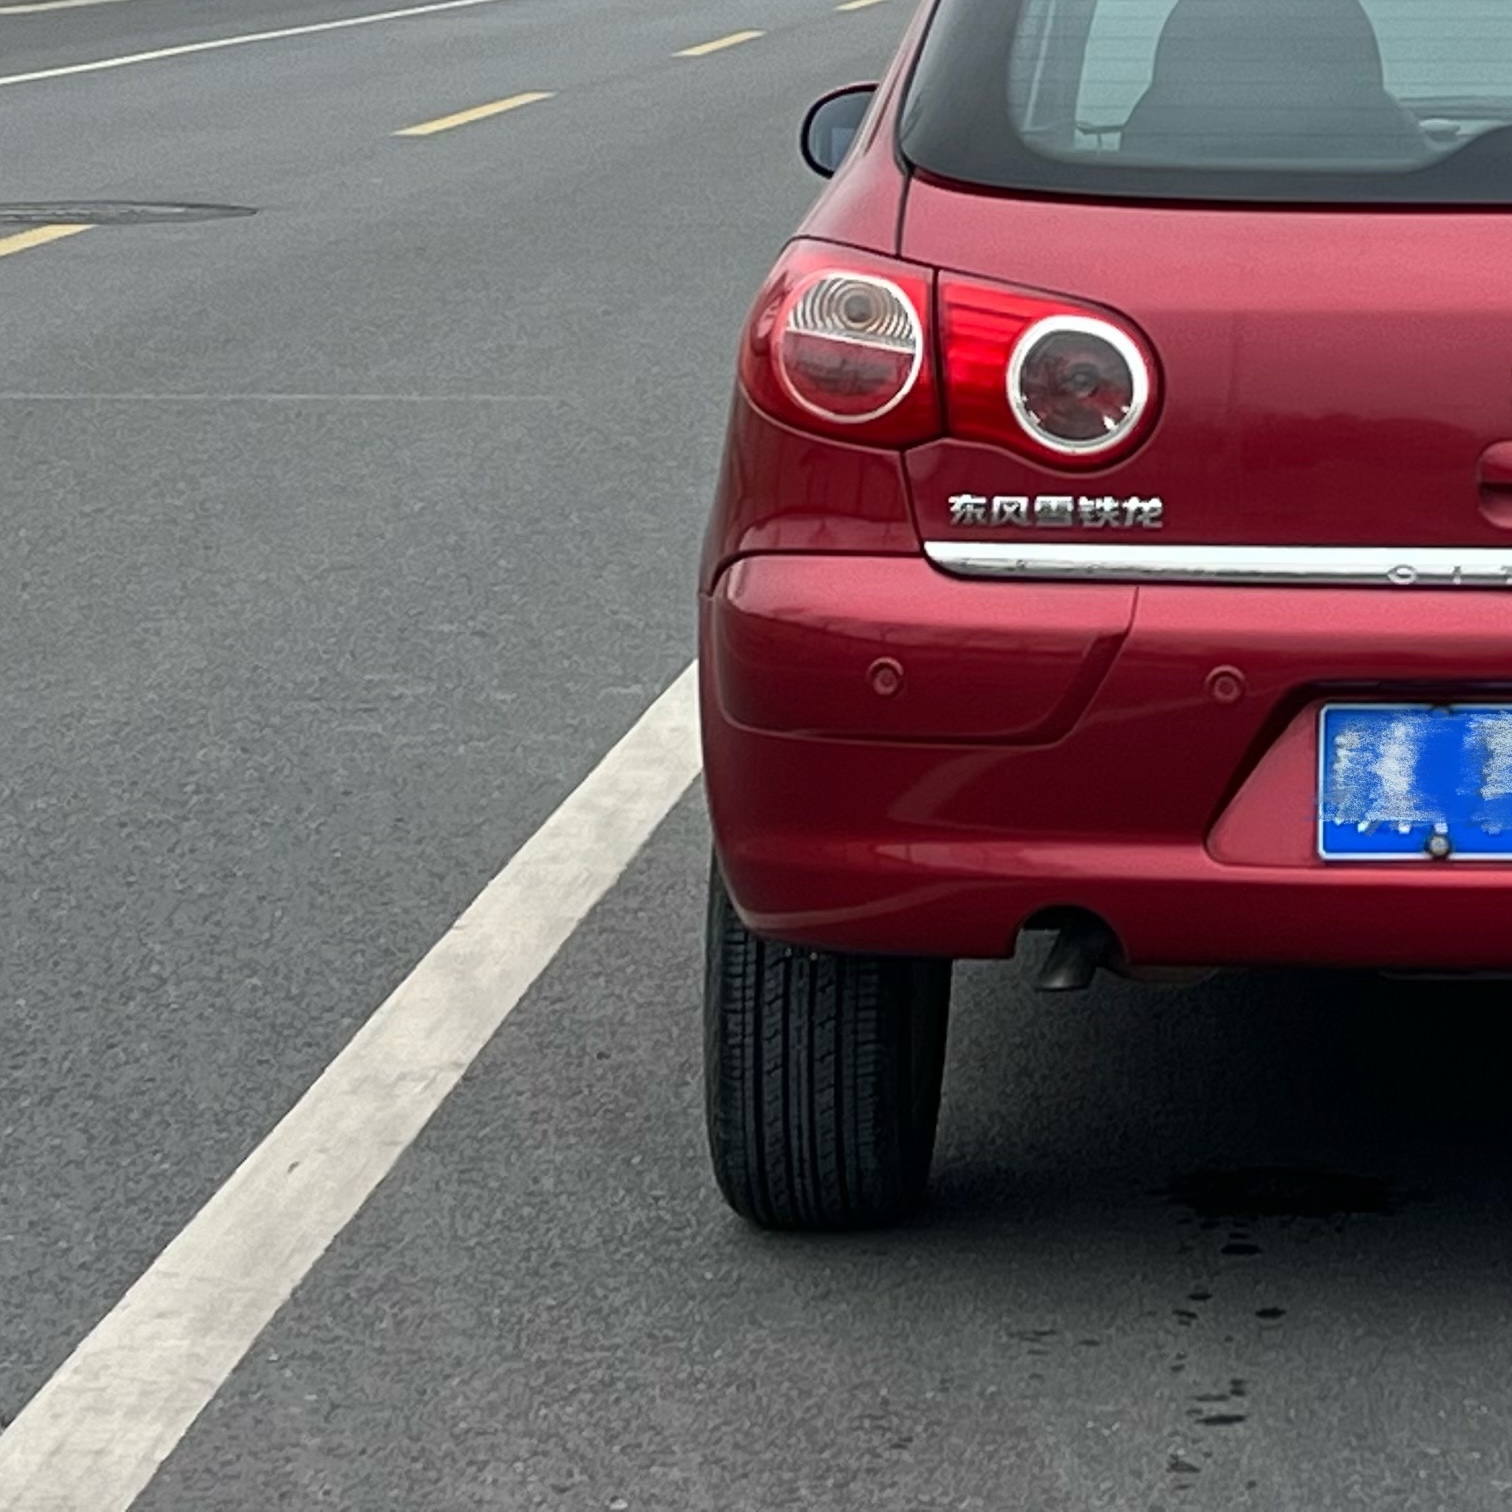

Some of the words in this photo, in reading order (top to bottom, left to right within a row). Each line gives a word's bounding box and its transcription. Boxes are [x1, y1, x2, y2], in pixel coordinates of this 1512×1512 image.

[948, 494, 1164, 528] 东风雪铁龙
